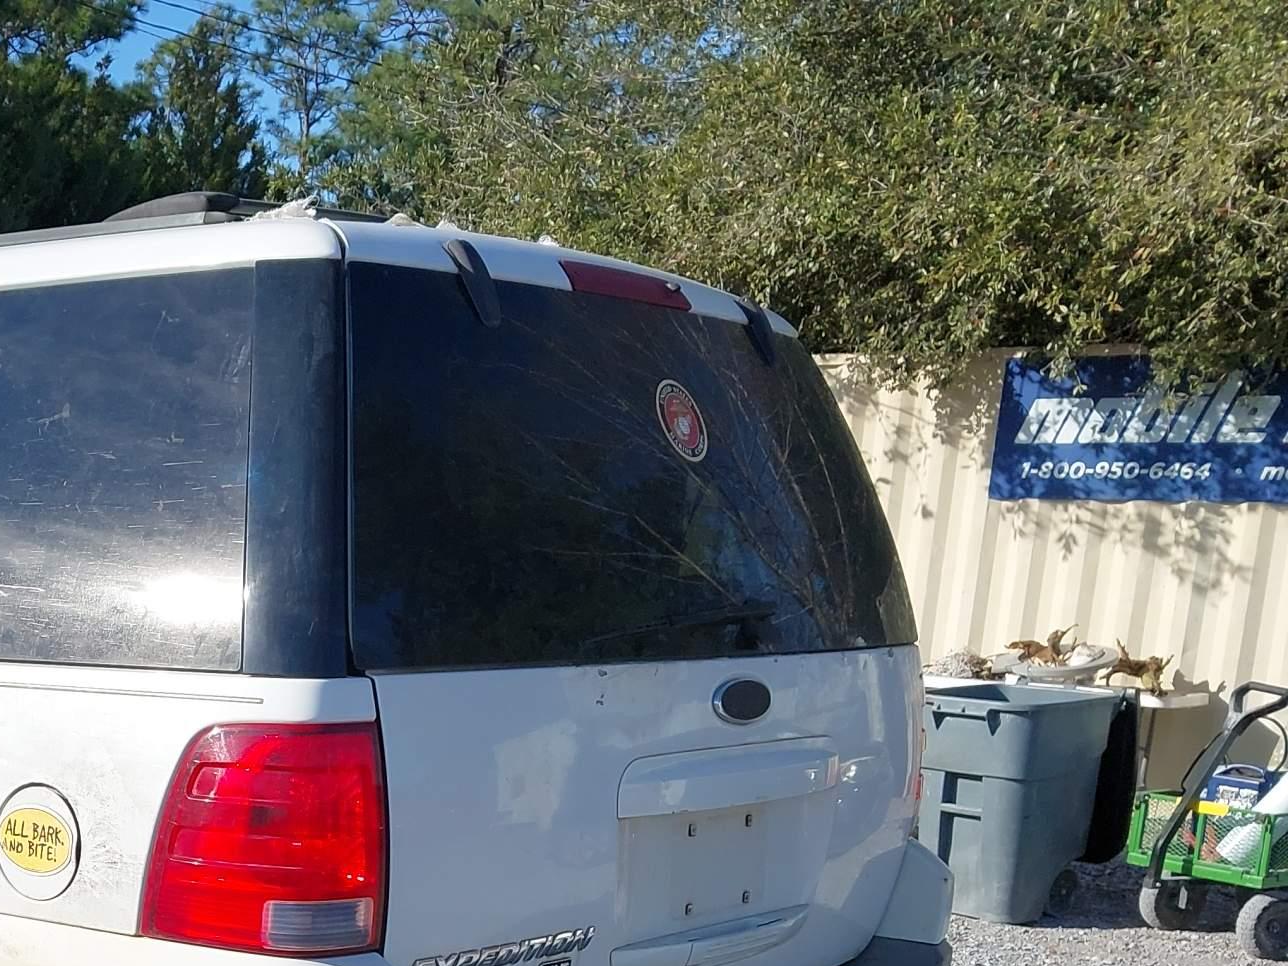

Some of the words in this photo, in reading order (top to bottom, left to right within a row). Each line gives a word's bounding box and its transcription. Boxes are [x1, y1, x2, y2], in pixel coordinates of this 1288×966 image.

[1020, 461, 1212, 481] 1-800-950-6464
[5, 818, 29, 838] ALL
[1, 837, 24, 854] AND
[27, 840, 57, 862] BITE!
